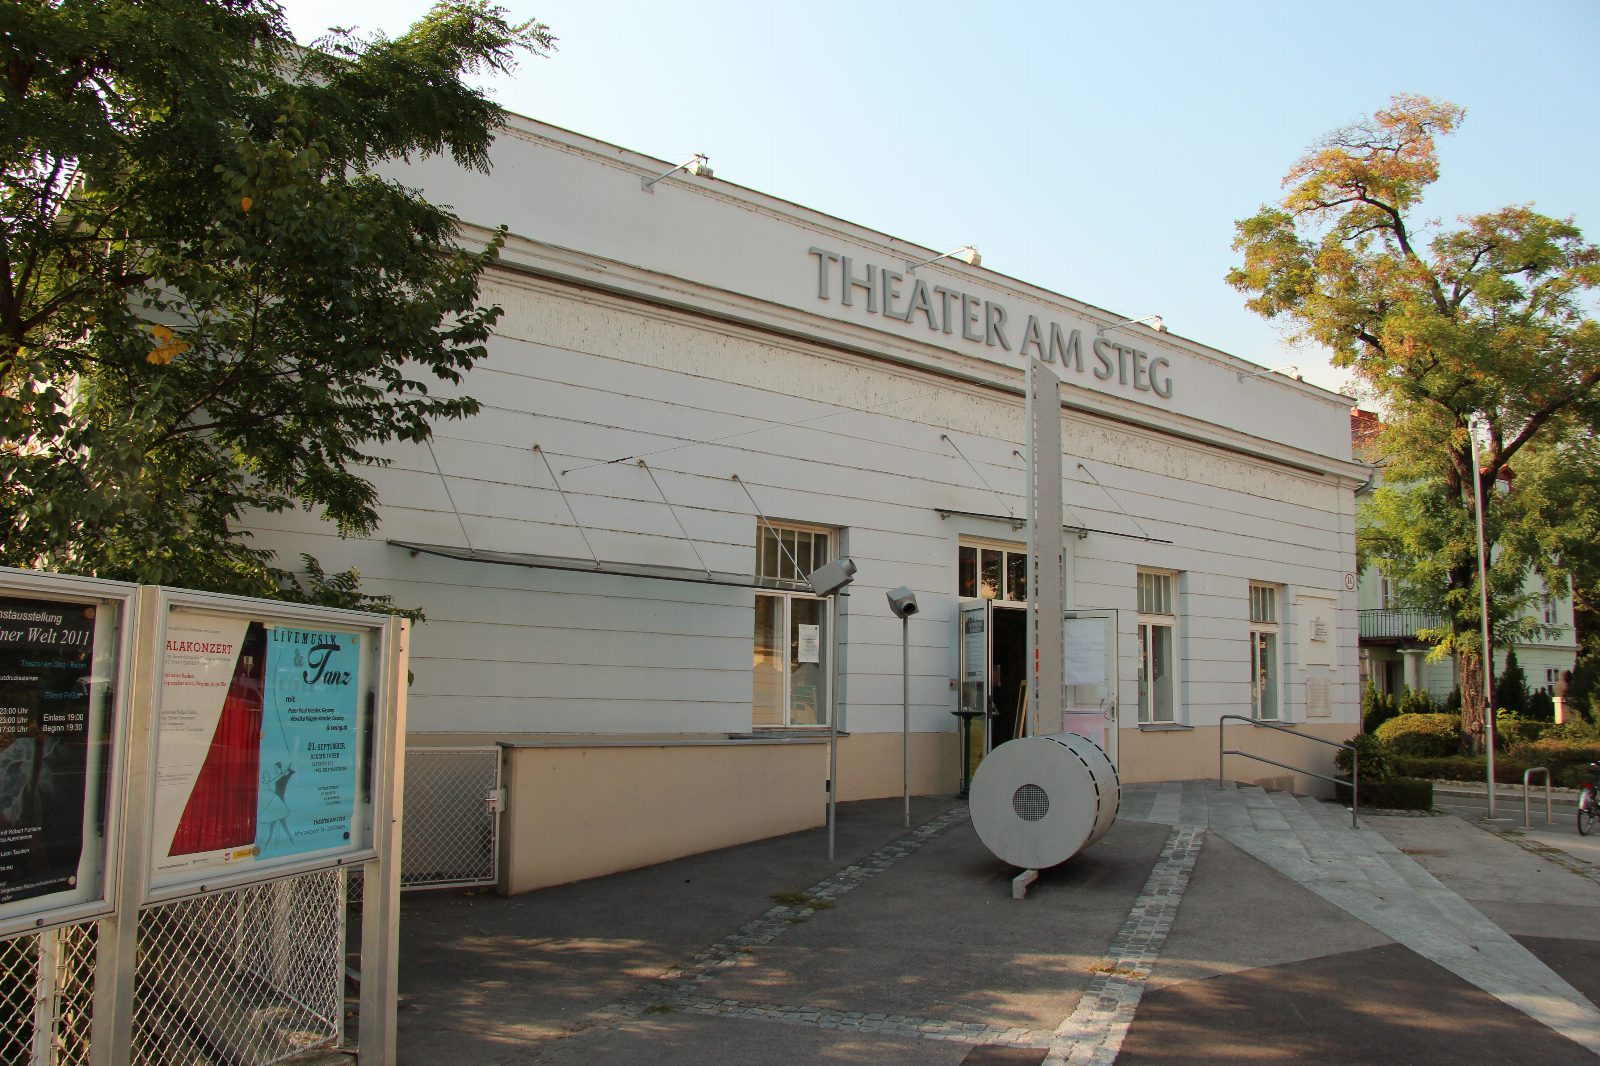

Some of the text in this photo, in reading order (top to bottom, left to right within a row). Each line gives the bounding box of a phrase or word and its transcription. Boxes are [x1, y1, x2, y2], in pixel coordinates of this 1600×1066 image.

[808, 246, 1174, 398] THEATER AM STEG
[0, 626, 90, 646] ner Welt 2011
[273, 629, 337, 646] LIVEMUSIK
[166, 640, 233, 654] ALAKONZERT
[303, 643, 351, 685] Tanz
[285, 695, 296, 703] mit
[17, 707, 29, 715] Uhr
[17, 716, 28, 724] Uhr
[43, 713, 84, 722] Einlass 19:00
[17, 725, 28, 733] Uhr
[42, 723, 83, 733] Beginn 19:30
[308, 742, 317, 751] 21.
